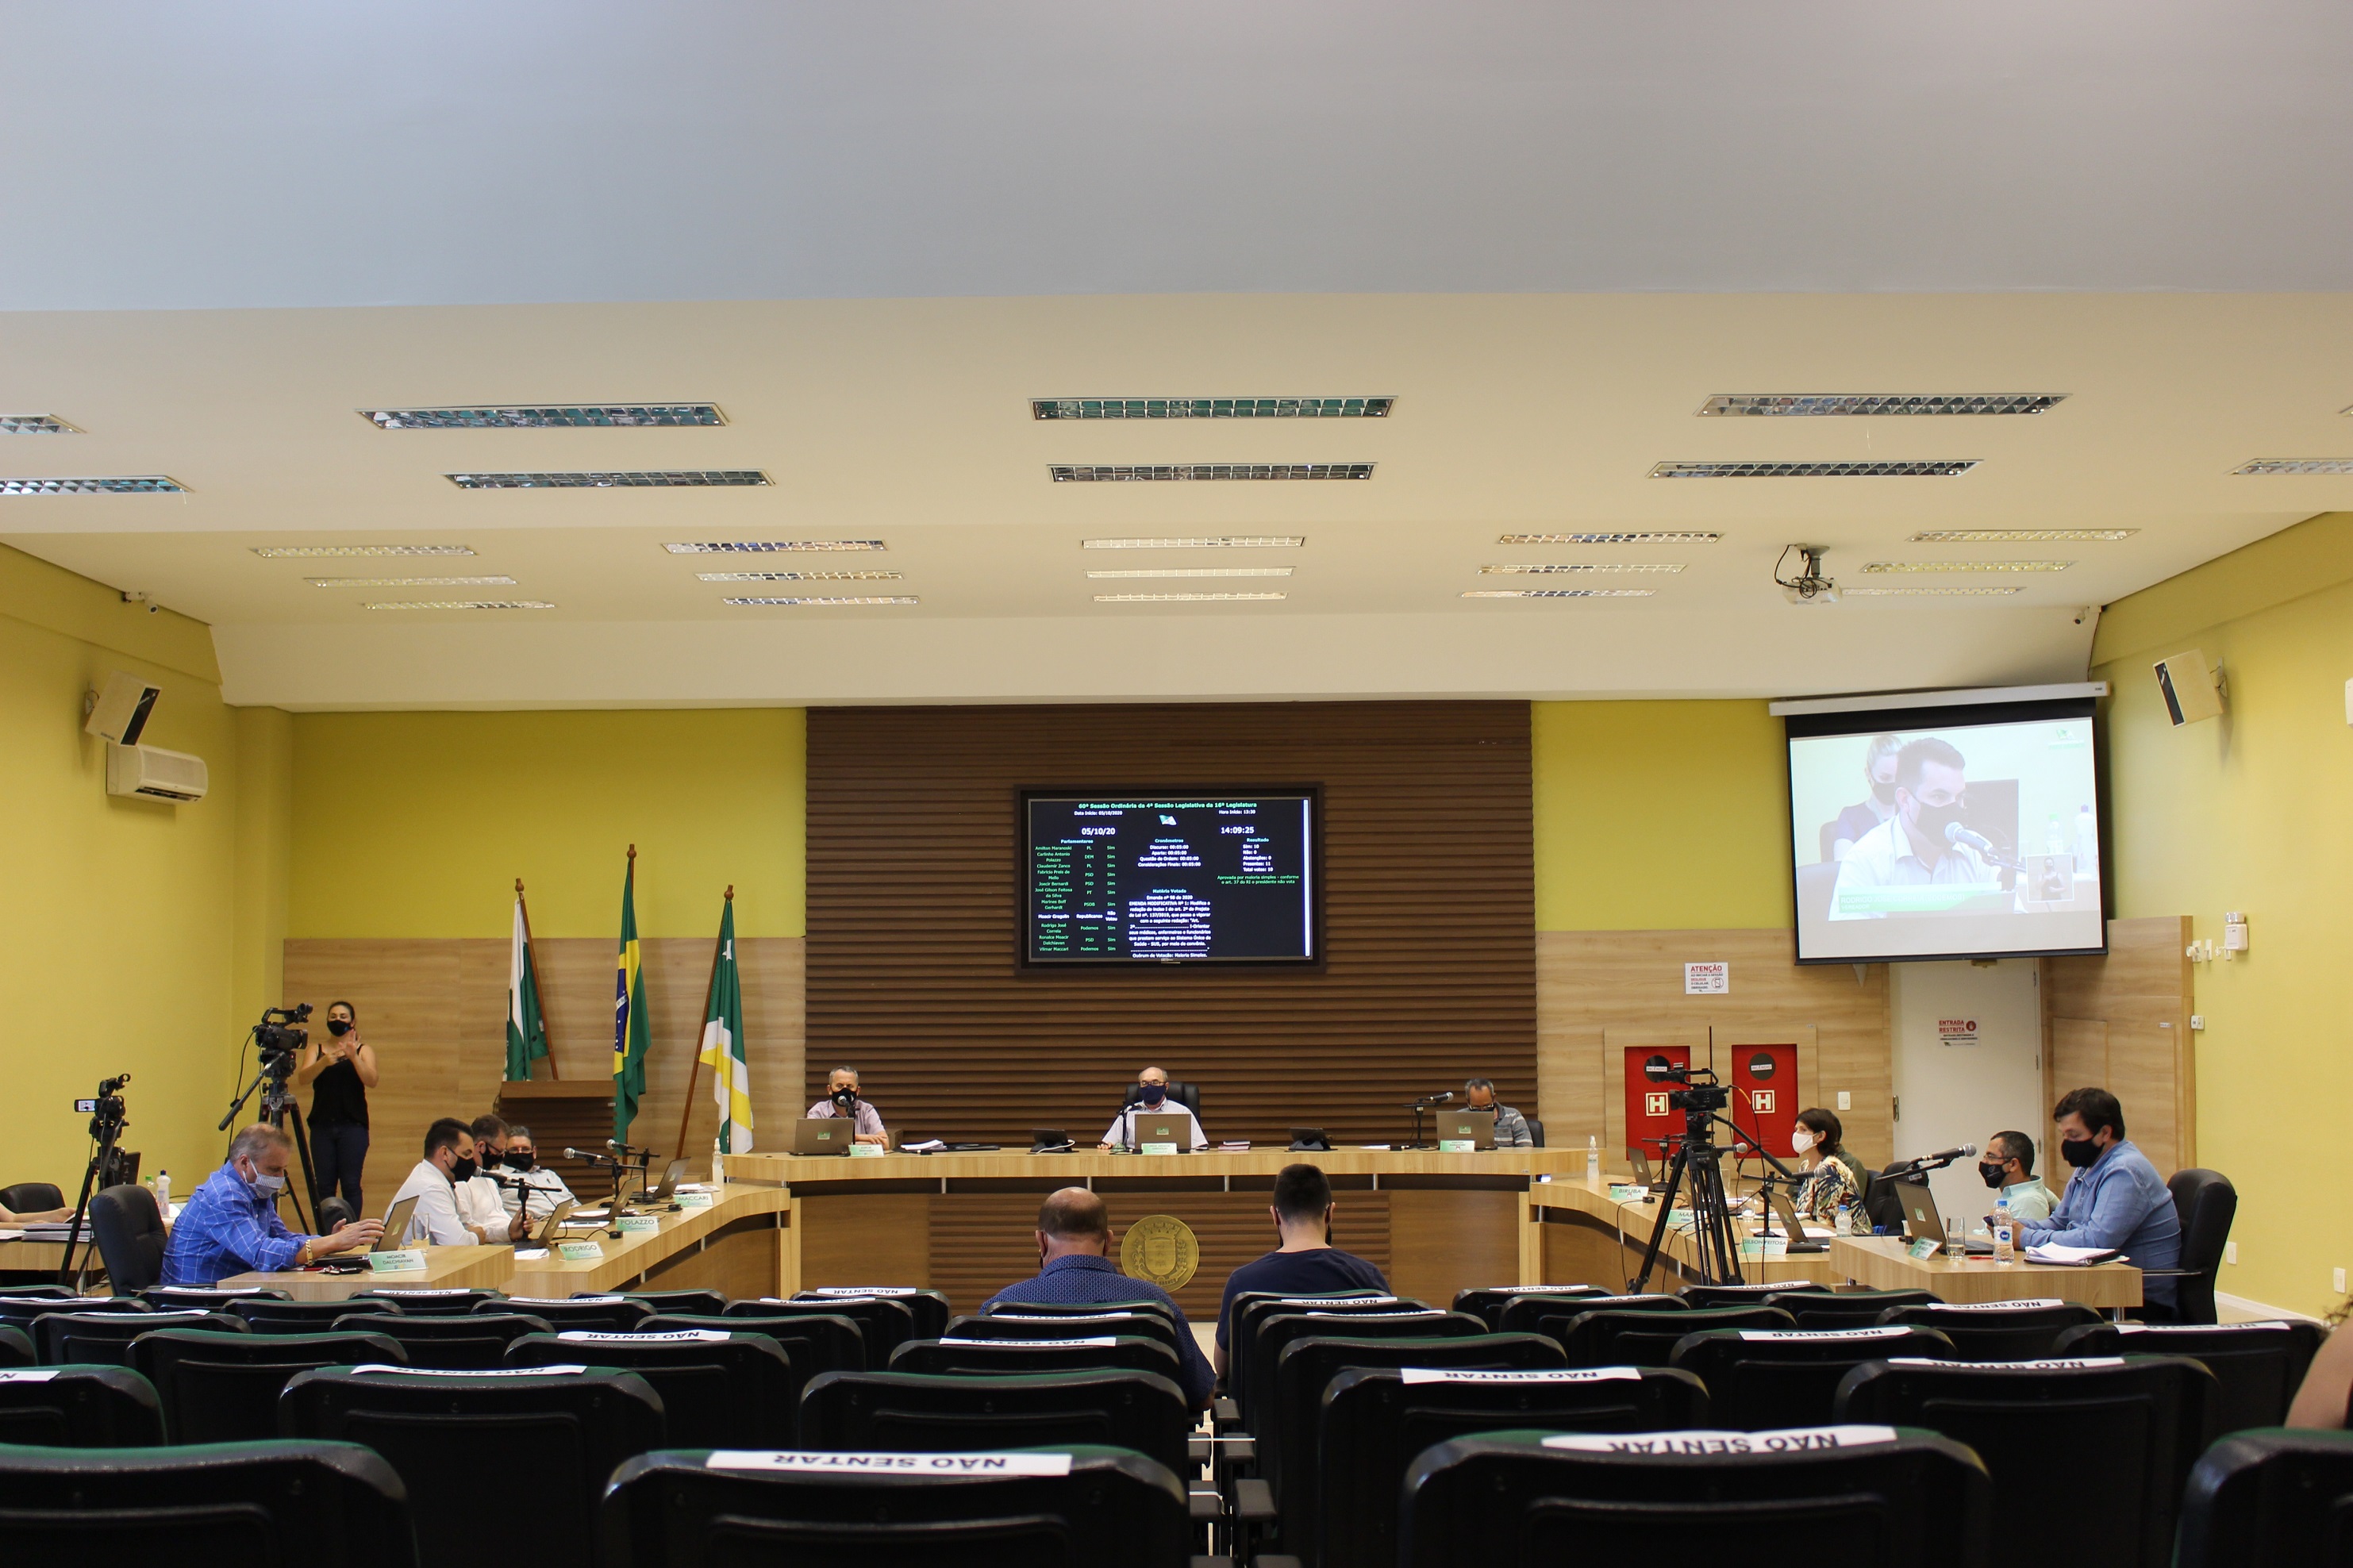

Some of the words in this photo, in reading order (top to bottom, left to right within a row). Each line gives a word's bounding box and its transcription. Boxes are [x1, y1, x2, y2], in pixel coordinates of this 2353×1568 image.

[1691, 964, 1722, 973] ATENÇÃO
[1649, 1096, 1665, 1113] H
[1755, 1093, 1771, 1109] H
[774, 1455, 917, 1469] SENTAR
[932, 1458, 1006, 1471] NÃO
